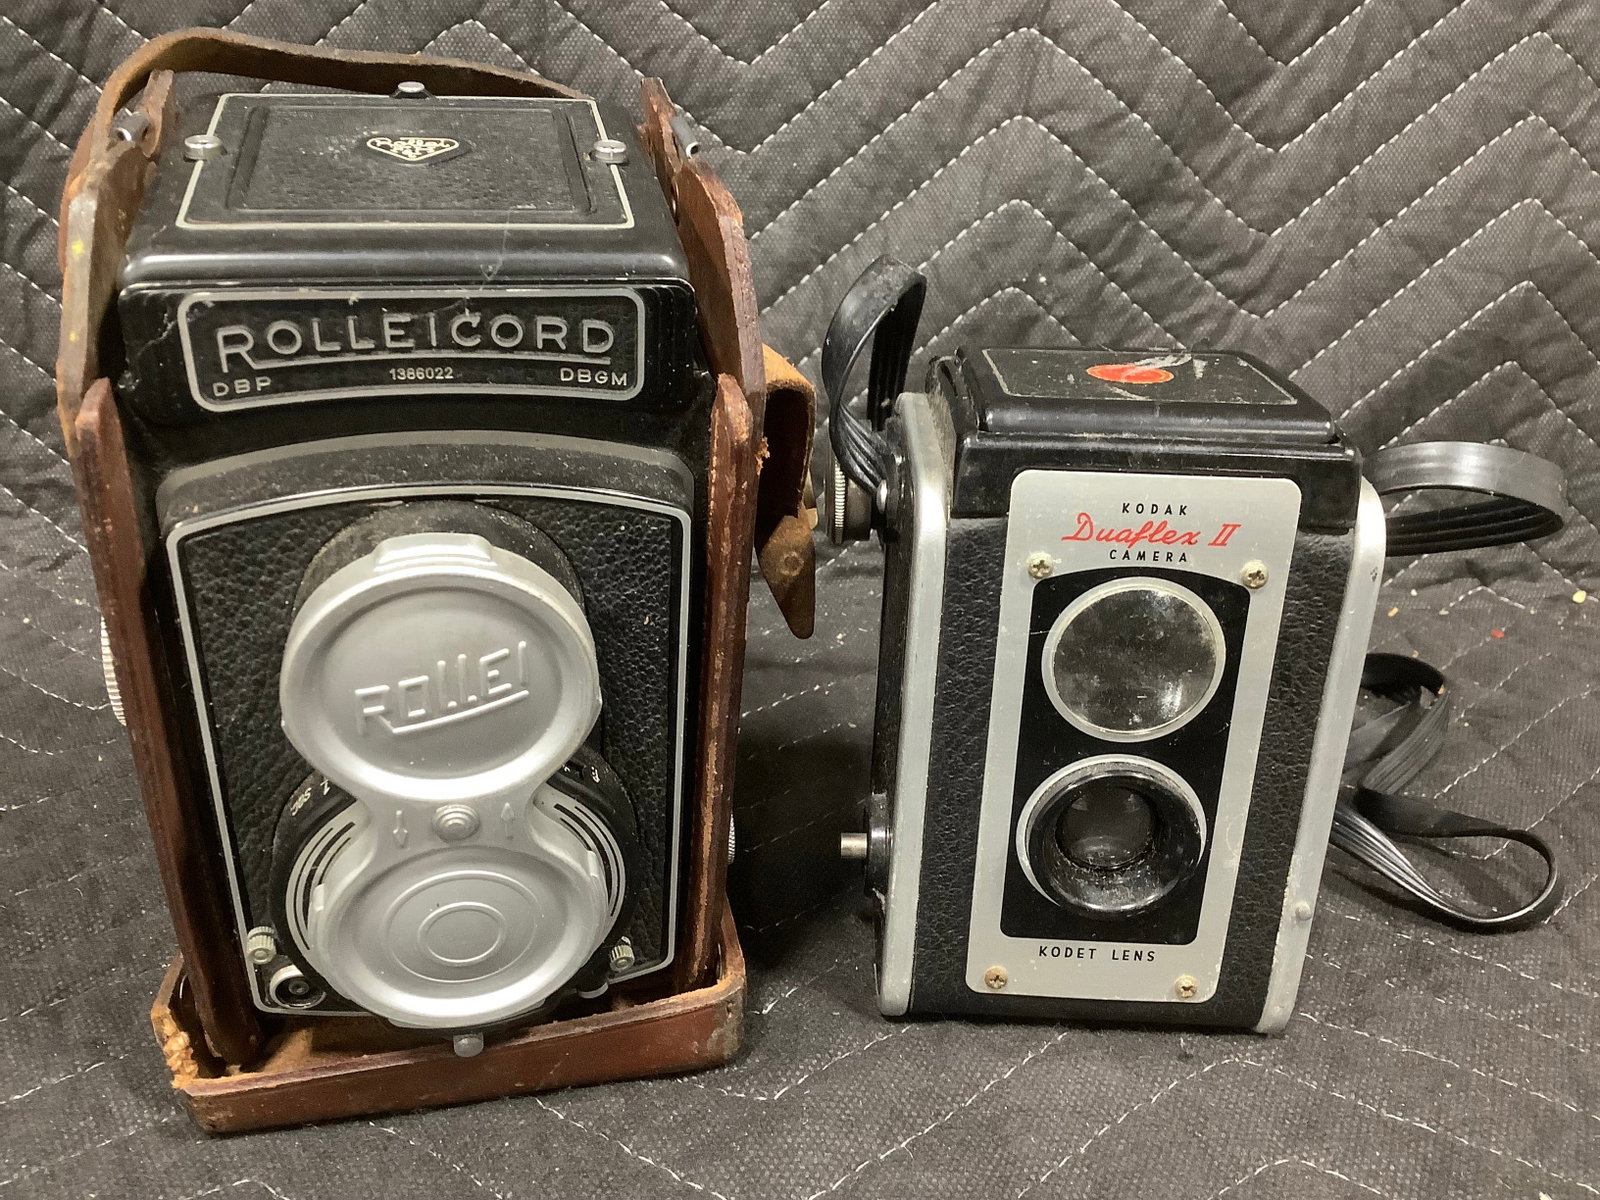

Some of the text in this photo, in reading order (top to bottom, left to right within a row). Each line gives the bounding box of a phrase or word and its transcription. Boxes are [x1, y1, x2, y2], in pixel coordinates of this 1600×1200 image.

[216, 312, 615, 373] ROLLEICORD
[389, 366, 454, 380] 1386022
[560, 367, 628, 386] DBGM
[213, 377, 272, 397] DBP
[1122, 503, 1188, 516] KODAK
[1061, 512, 1242, 548] Duaflex II
[1109, 549, 1188, 563] CAMERA
[1039, 945, 1156, 962] KODET LENS
